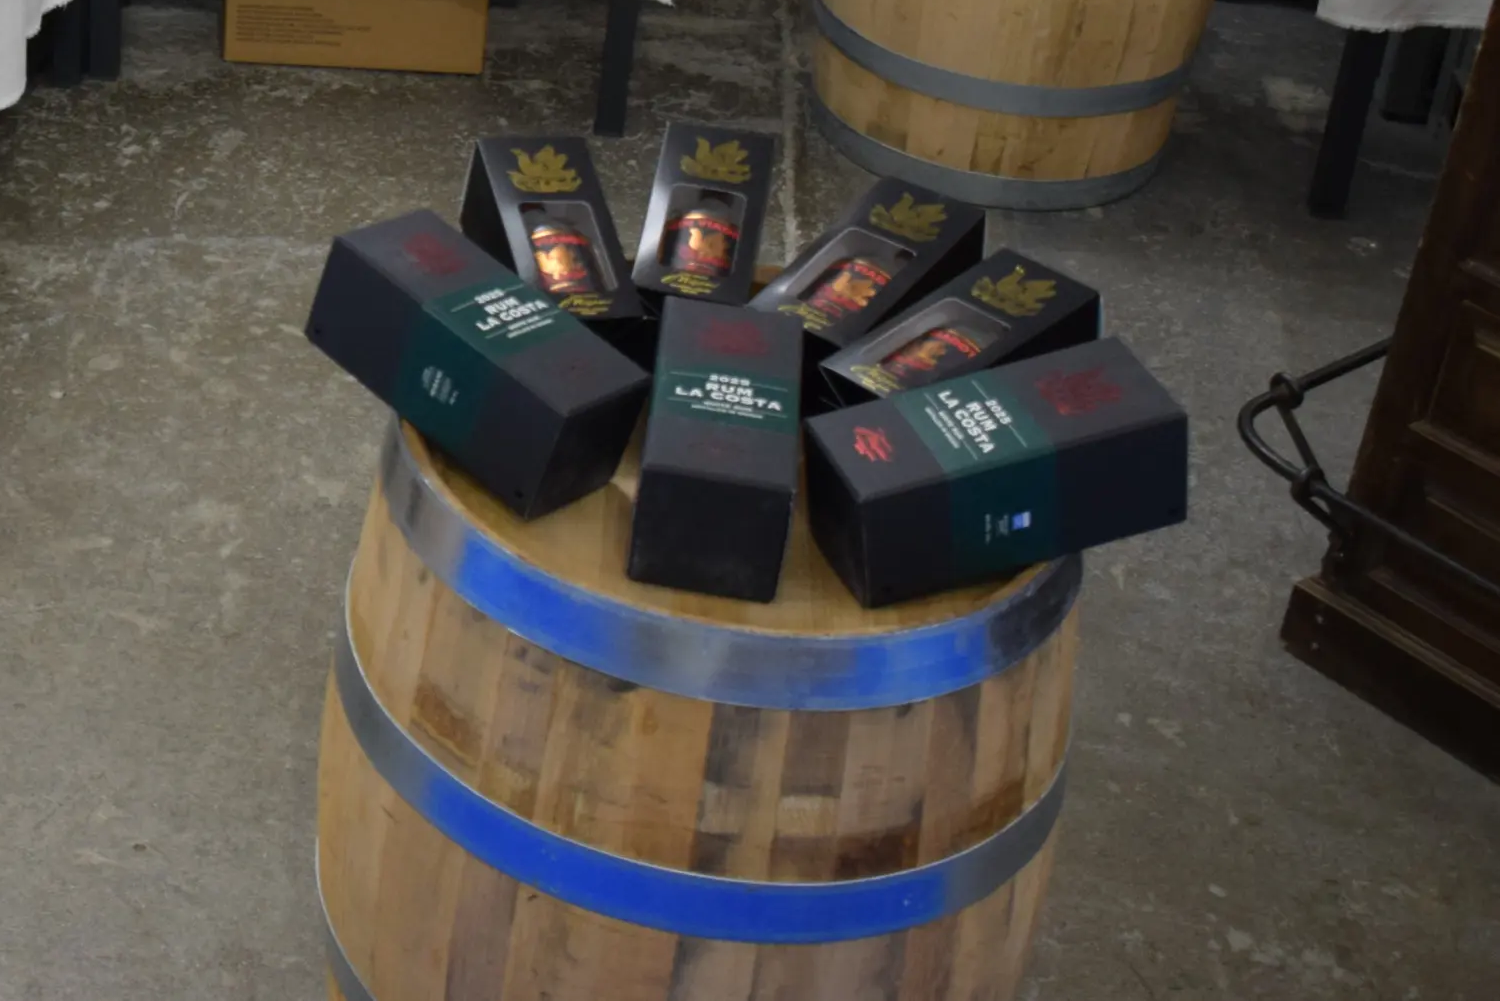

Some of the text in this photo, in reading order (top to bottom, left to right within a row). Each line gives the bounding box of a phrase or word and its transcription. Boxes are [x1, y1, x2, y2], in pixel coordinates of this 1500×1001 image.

[475, 316, 500, 331] LA
[499, 299, 550, 322] COSTA
[483, 296, 520, 316] RUM
[674, 385, 703, 398] LA
[710, 390, 782, 411] COSTA
[705, 382, 754, 397] RUM
[938, 390, 960, 409] LA
[954, 409, 995, 454] COSTA
[965, 401, 998, 432] RUM
